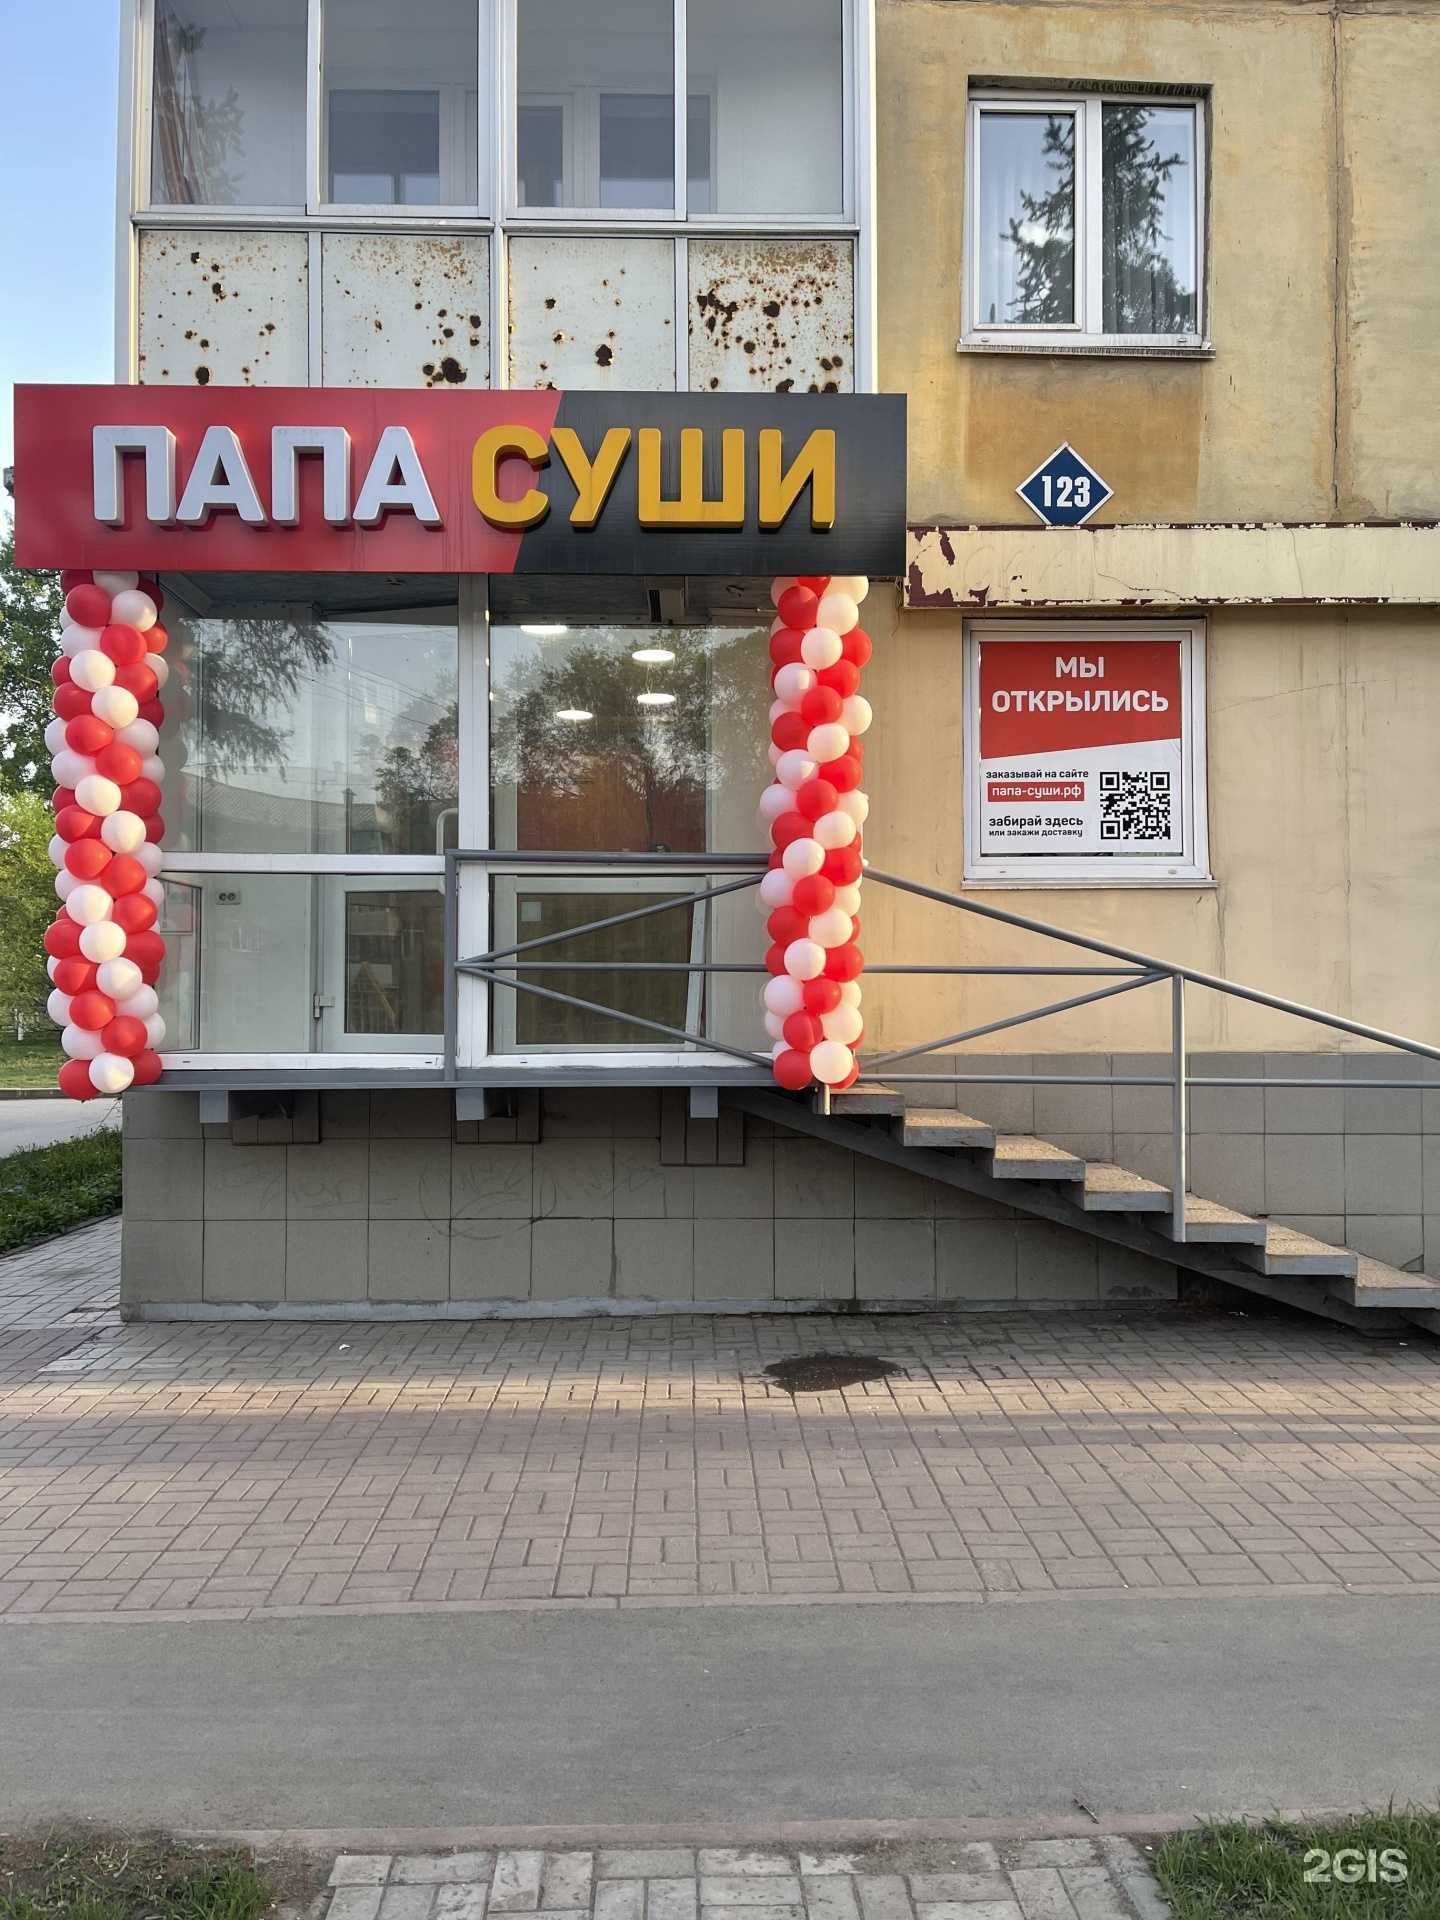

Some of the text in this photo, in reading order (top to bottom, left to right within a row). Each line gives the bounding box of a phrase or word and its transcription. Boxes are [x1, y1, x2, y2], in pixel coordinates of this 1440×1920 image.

[93, 425, 835, 529] ПАПА СУШИ
[1041, 475, 1091, 507] 123
[1055, 656, 1105, 678] МЫ
[991, 690, 1169, 713] ОТКРЫЛИСЬ
[986, 768, 1089, 779] заказывай на сайте
[992, 784, 1082, 799] папа-суши.рф
[988, 815, 1084, 829] забирай здесь
[988, 828, 1083, 838] или закажи доставку
